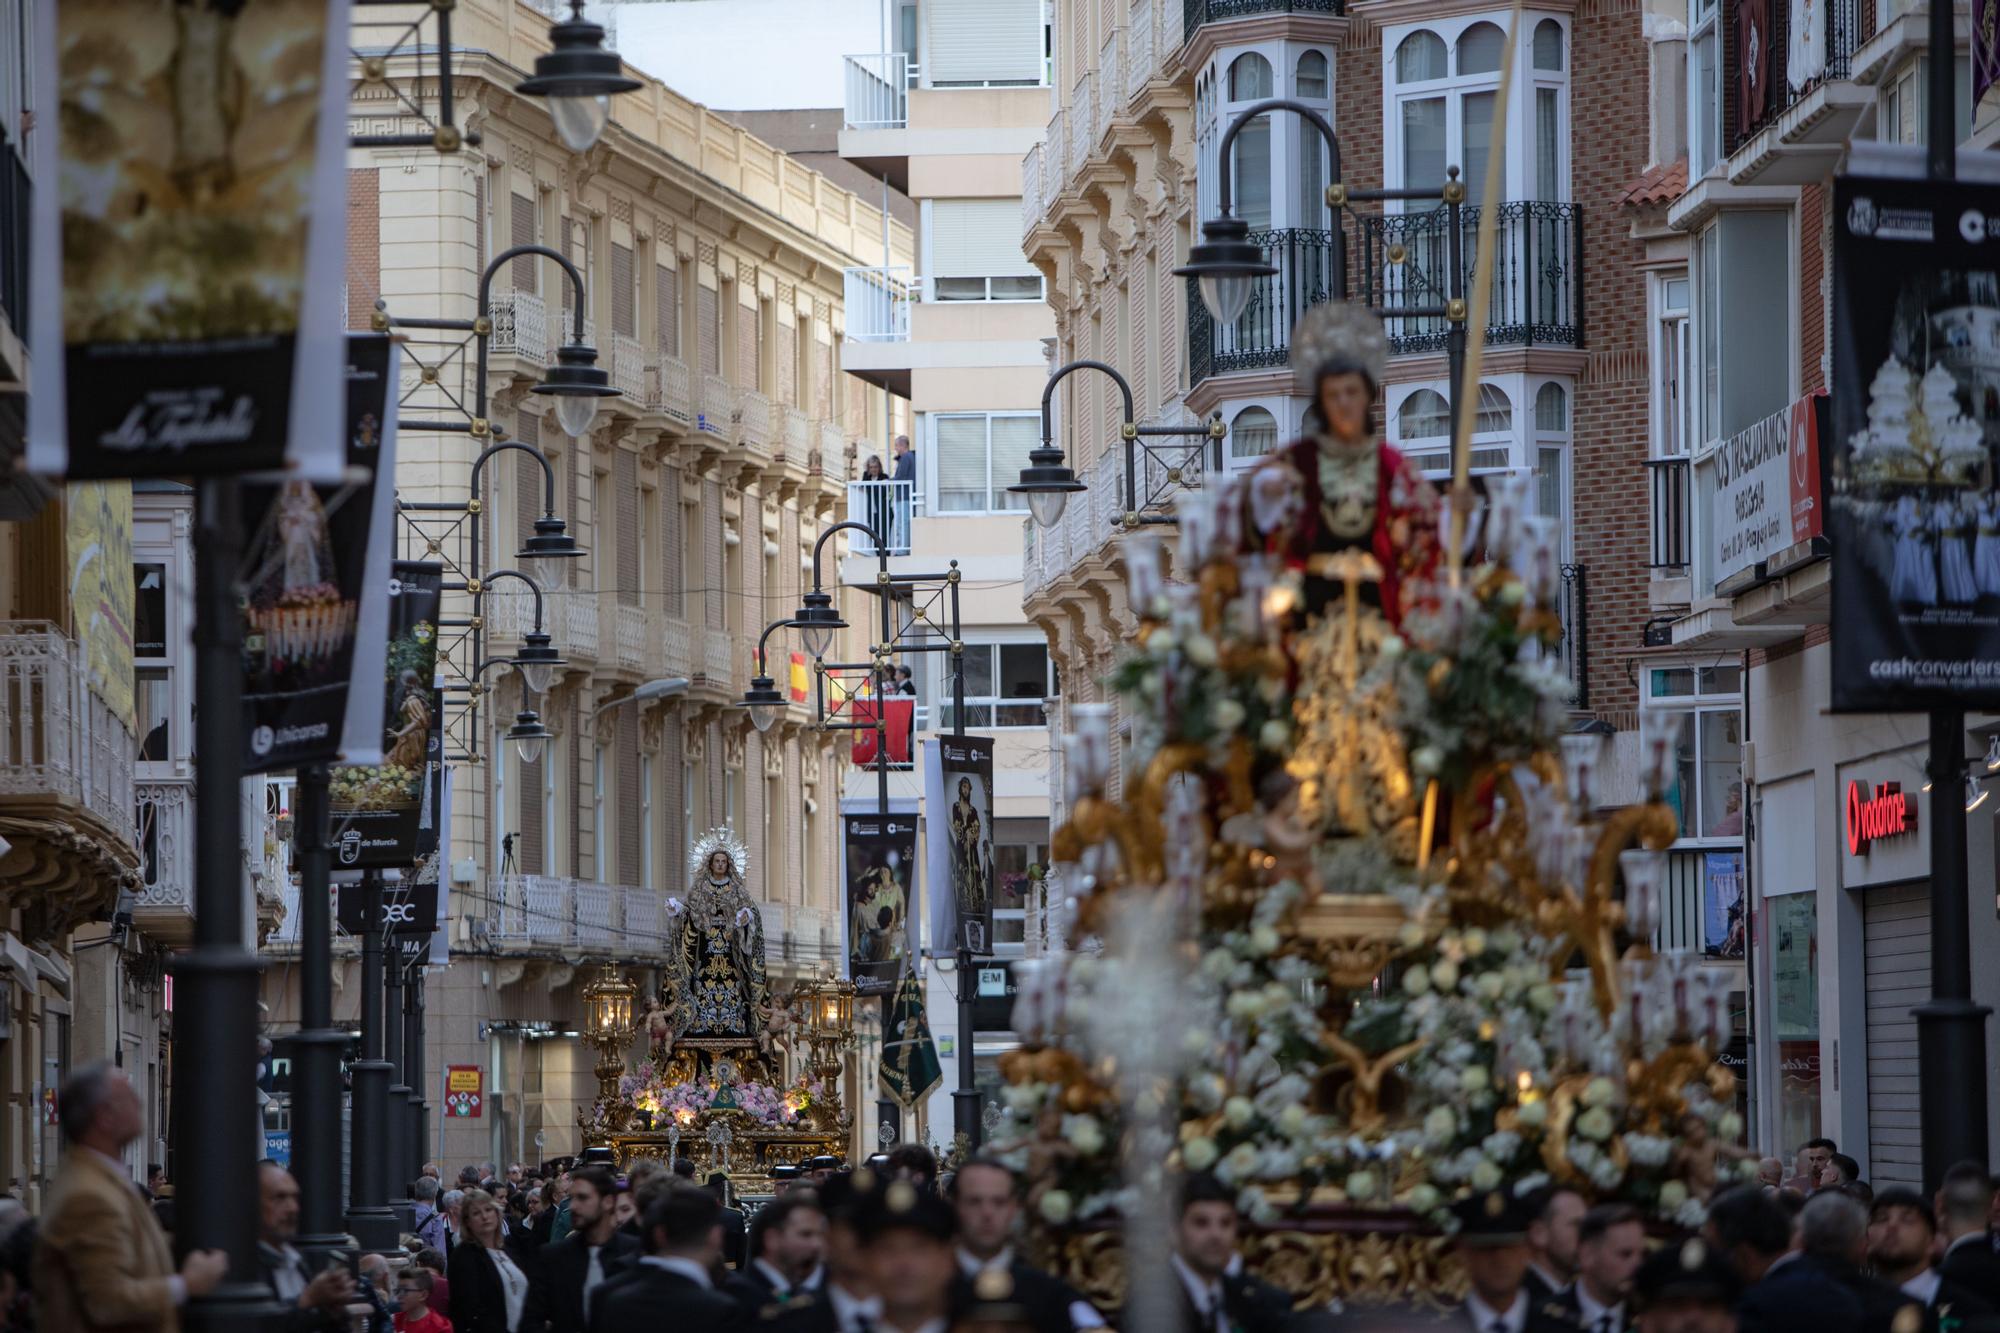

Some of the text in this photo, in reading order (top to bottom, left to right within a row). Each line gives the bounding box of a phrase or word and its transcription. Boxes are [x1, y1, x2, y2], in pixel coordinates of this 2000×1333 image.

[1870, 656, 2000, 679] cashconverters
[1860, 780, 1906, 840] vodafone
[372, 838, 398, 847] Murcia
